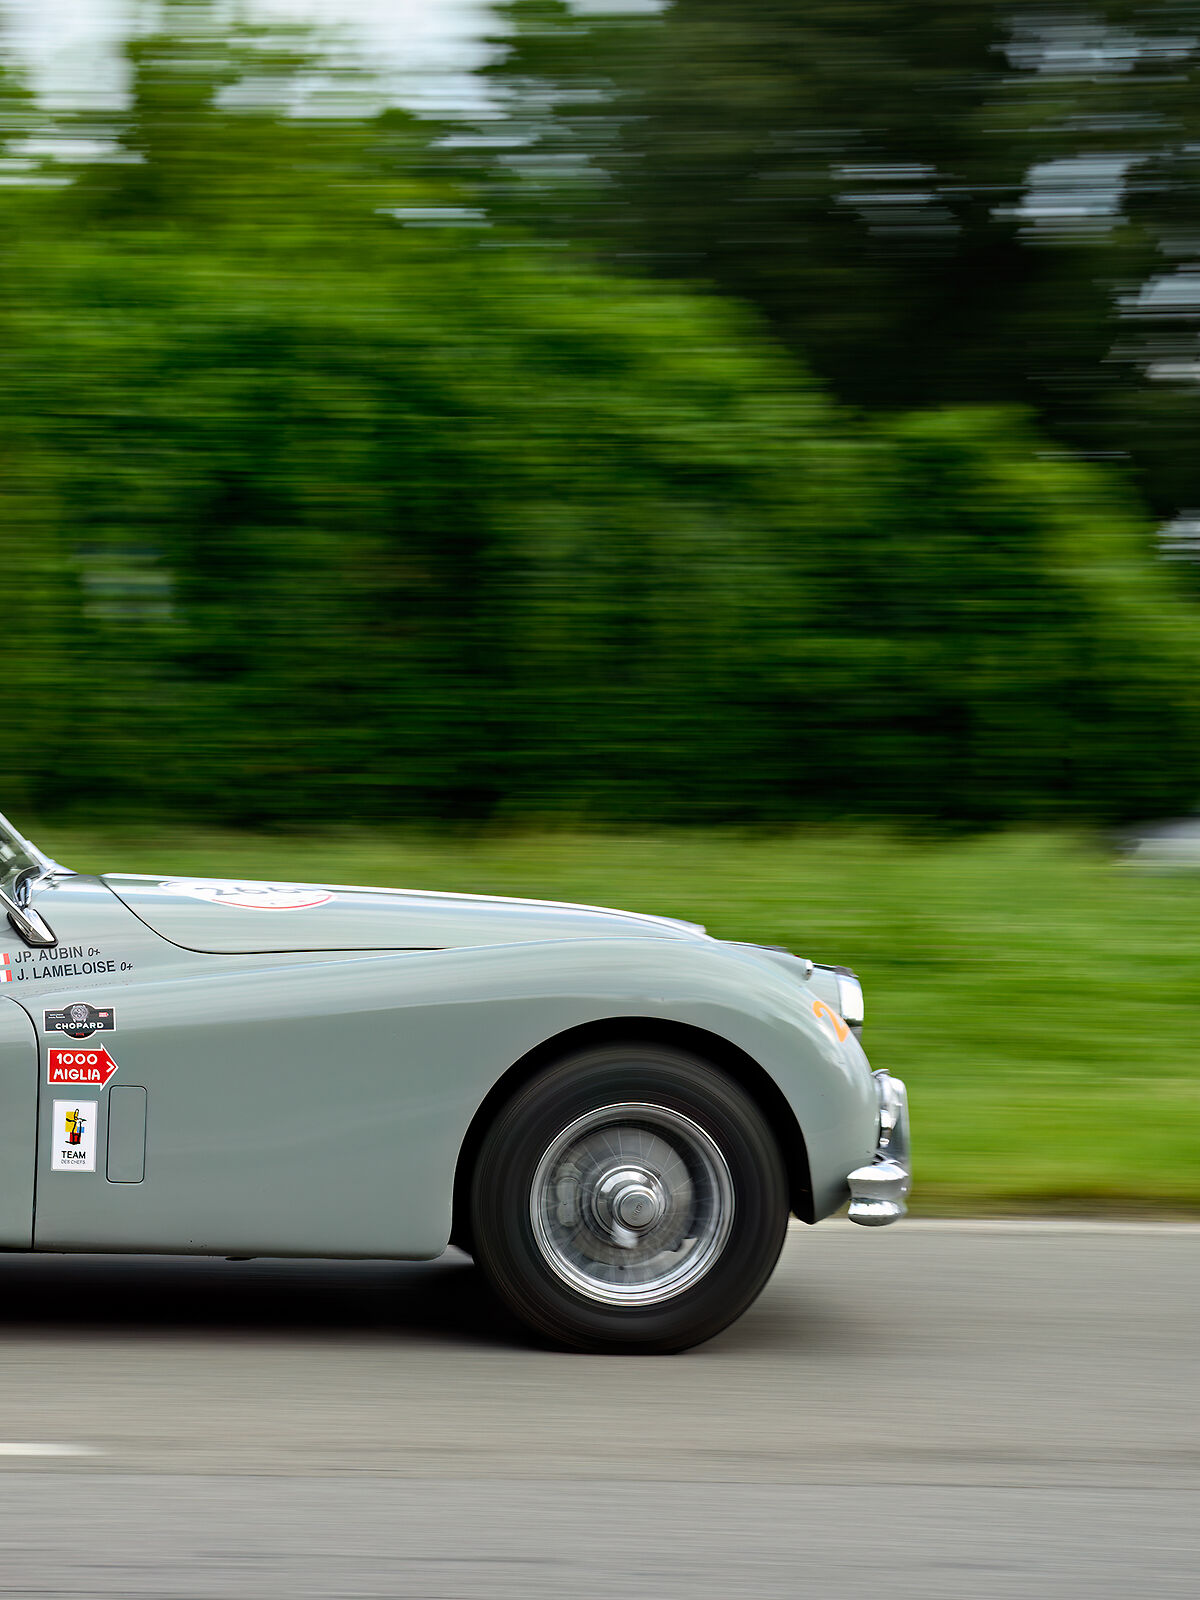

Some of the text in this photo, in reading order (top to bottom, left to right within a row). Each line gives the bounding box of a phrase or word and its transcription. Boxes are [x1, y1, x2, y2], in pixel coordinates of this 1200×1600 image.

[14, 951, 35, 964] JP.
[38, 946, 84, 962] AUBIN
[17, 968, 29, 981] J.
[33, 960, 116, 979] LAMELOISE
[55, 1022, 104, 1030] CHOPARD
[56, 1053, 98, 1065] 1000
[53, 1068, 101, 1081] MIGLIA
[61, 1150, 86, 1159] TEAM
